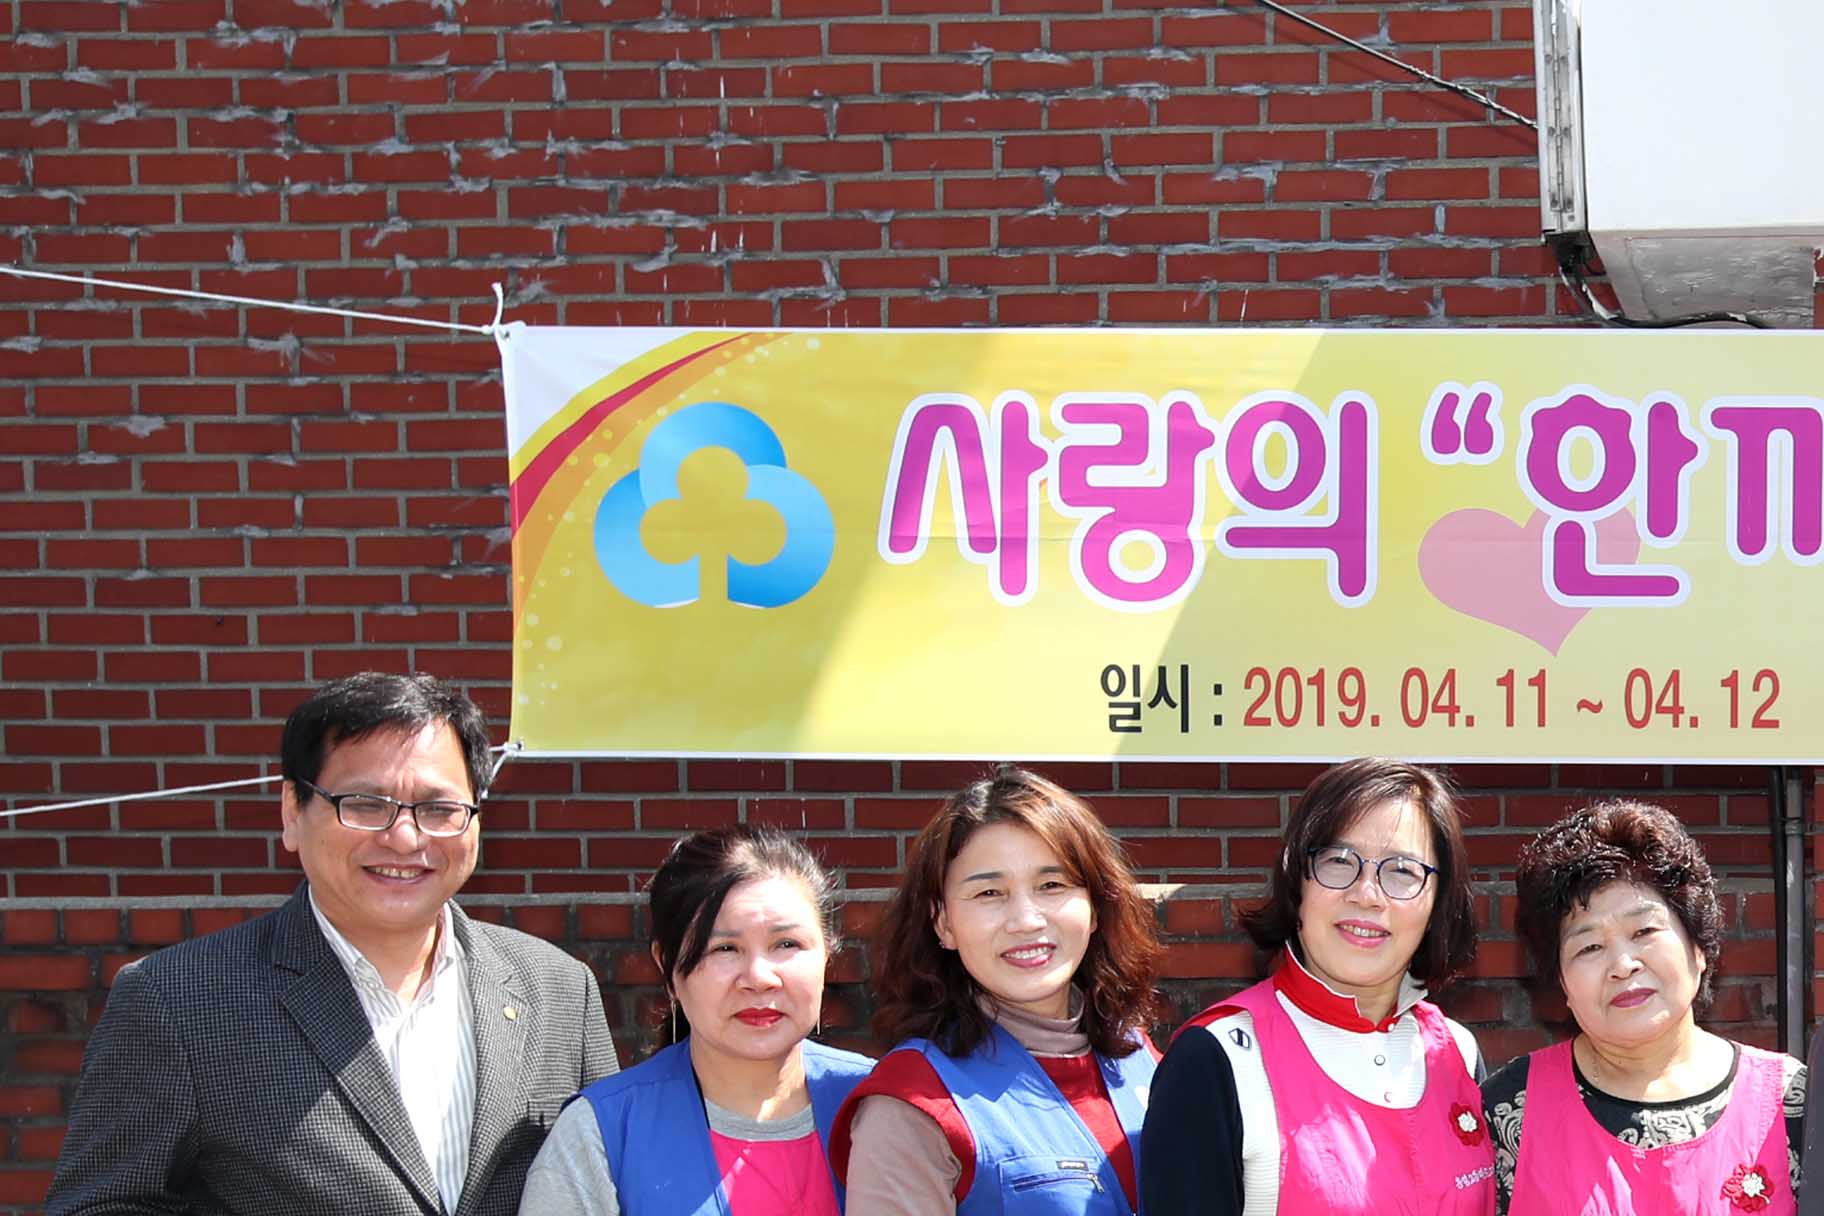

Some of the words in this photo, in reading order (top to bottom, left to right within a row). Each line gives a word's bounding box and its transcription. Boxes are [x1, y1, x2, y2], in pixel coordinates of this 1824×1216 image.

[884, 397, 1372, 604] 사랑의
[1101, 664, 1189, 733] 일시
[1245, 667, 1380, 728] 2019.
[1401, 667, 1474, 728] 04.
[1497, 669, 1546, 728] 11
[1624, 668, 1699, 729] 04.
[1721, 669, 1780, 729] 12
